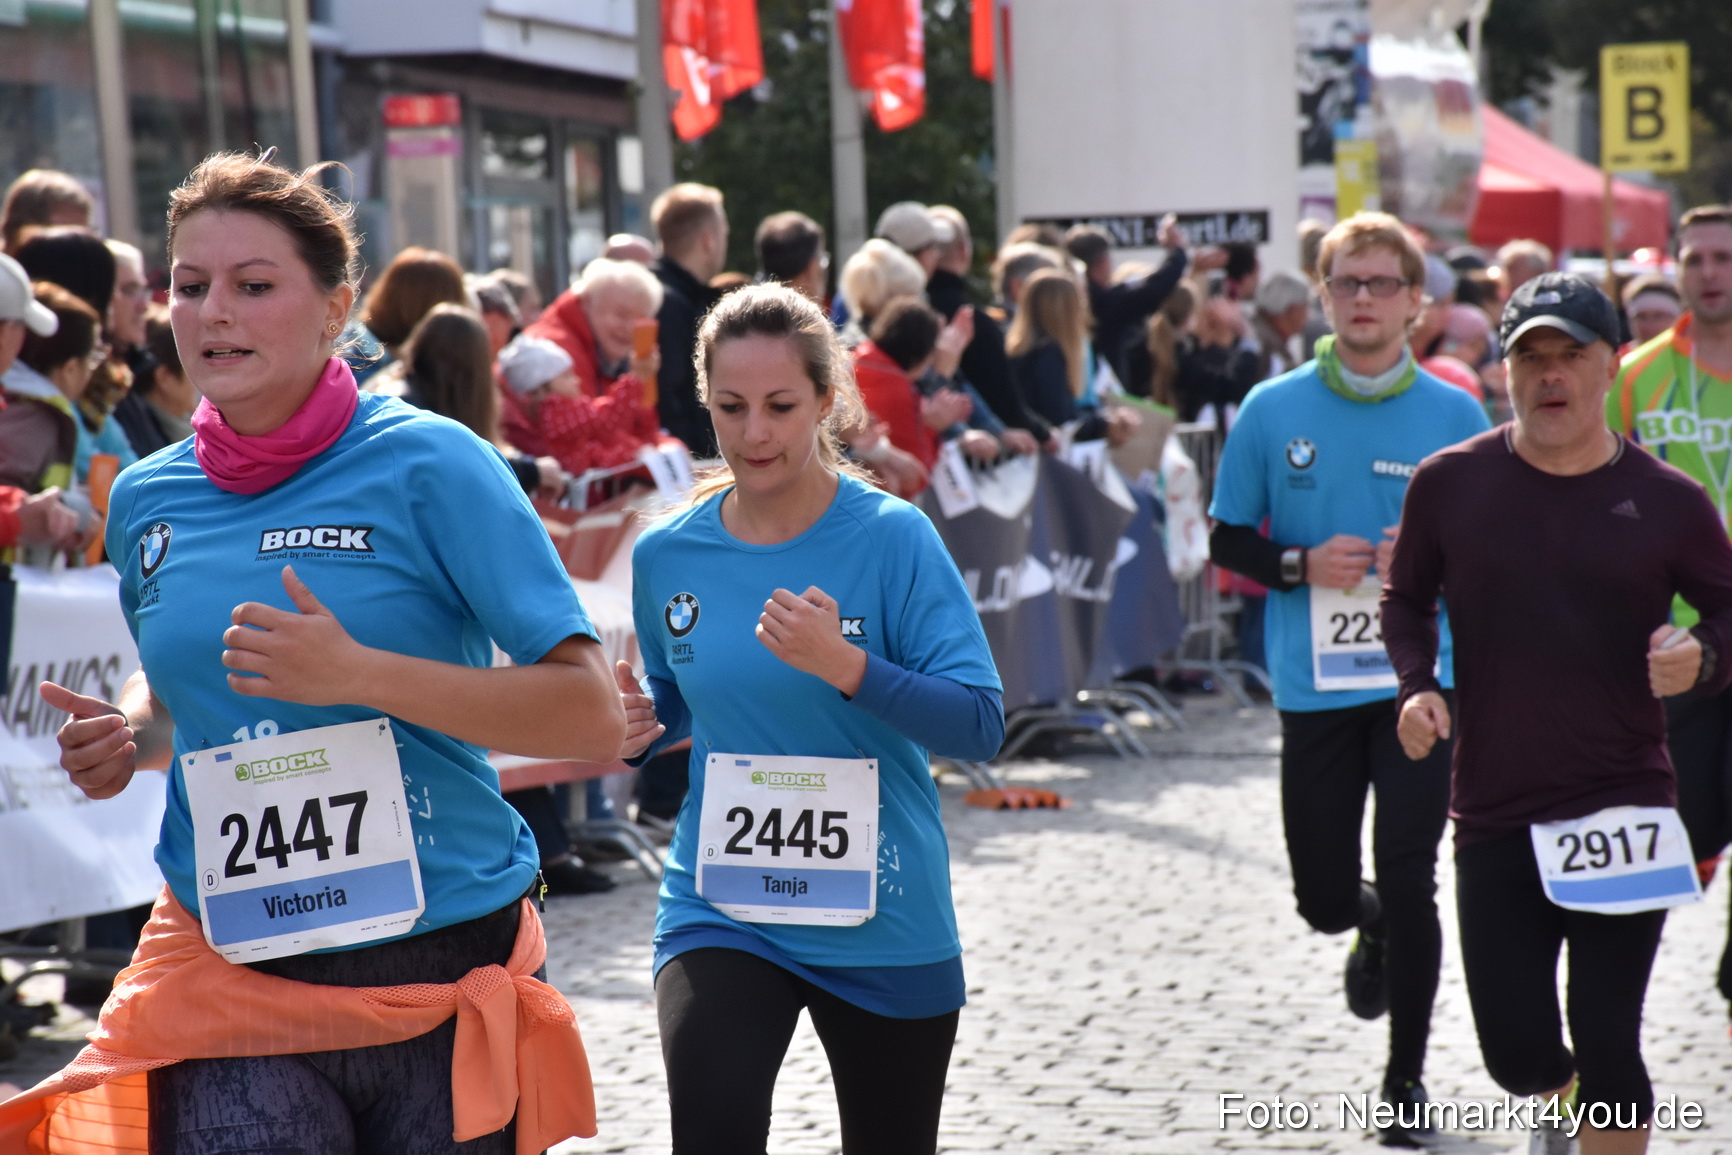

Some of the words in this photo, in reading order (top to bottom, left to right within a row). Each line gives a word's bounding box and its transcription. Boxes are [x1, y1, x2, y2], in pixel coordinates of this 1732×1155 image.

[1626, 85, 1664, 142] B
[1372, 460, 1419, 479] BOC
[259, 526, 376, 553] BOCK
[255, 552, 287, 562] inspired
[290, 551, 300, 560] by
[333, 552, 376, 561] concepts
[251, 748, 330, 779] BOCK
[276, 774, 285, 783] by
[285, 771, 304, 780] smart
[304, 766, 332, 776] concepts
[768, 771, 827, 787] BOCK
[220, 790, 369, 878] 2447
[724, 806, 849, 860] 2445
[707, 847, 714, 857] D
[1557, 822, 1660, 874] 2917
[207, 874, 214, 886] D
[762, 875, 808, 898] Tanja
[262, 885, 348, 920] Victoria
